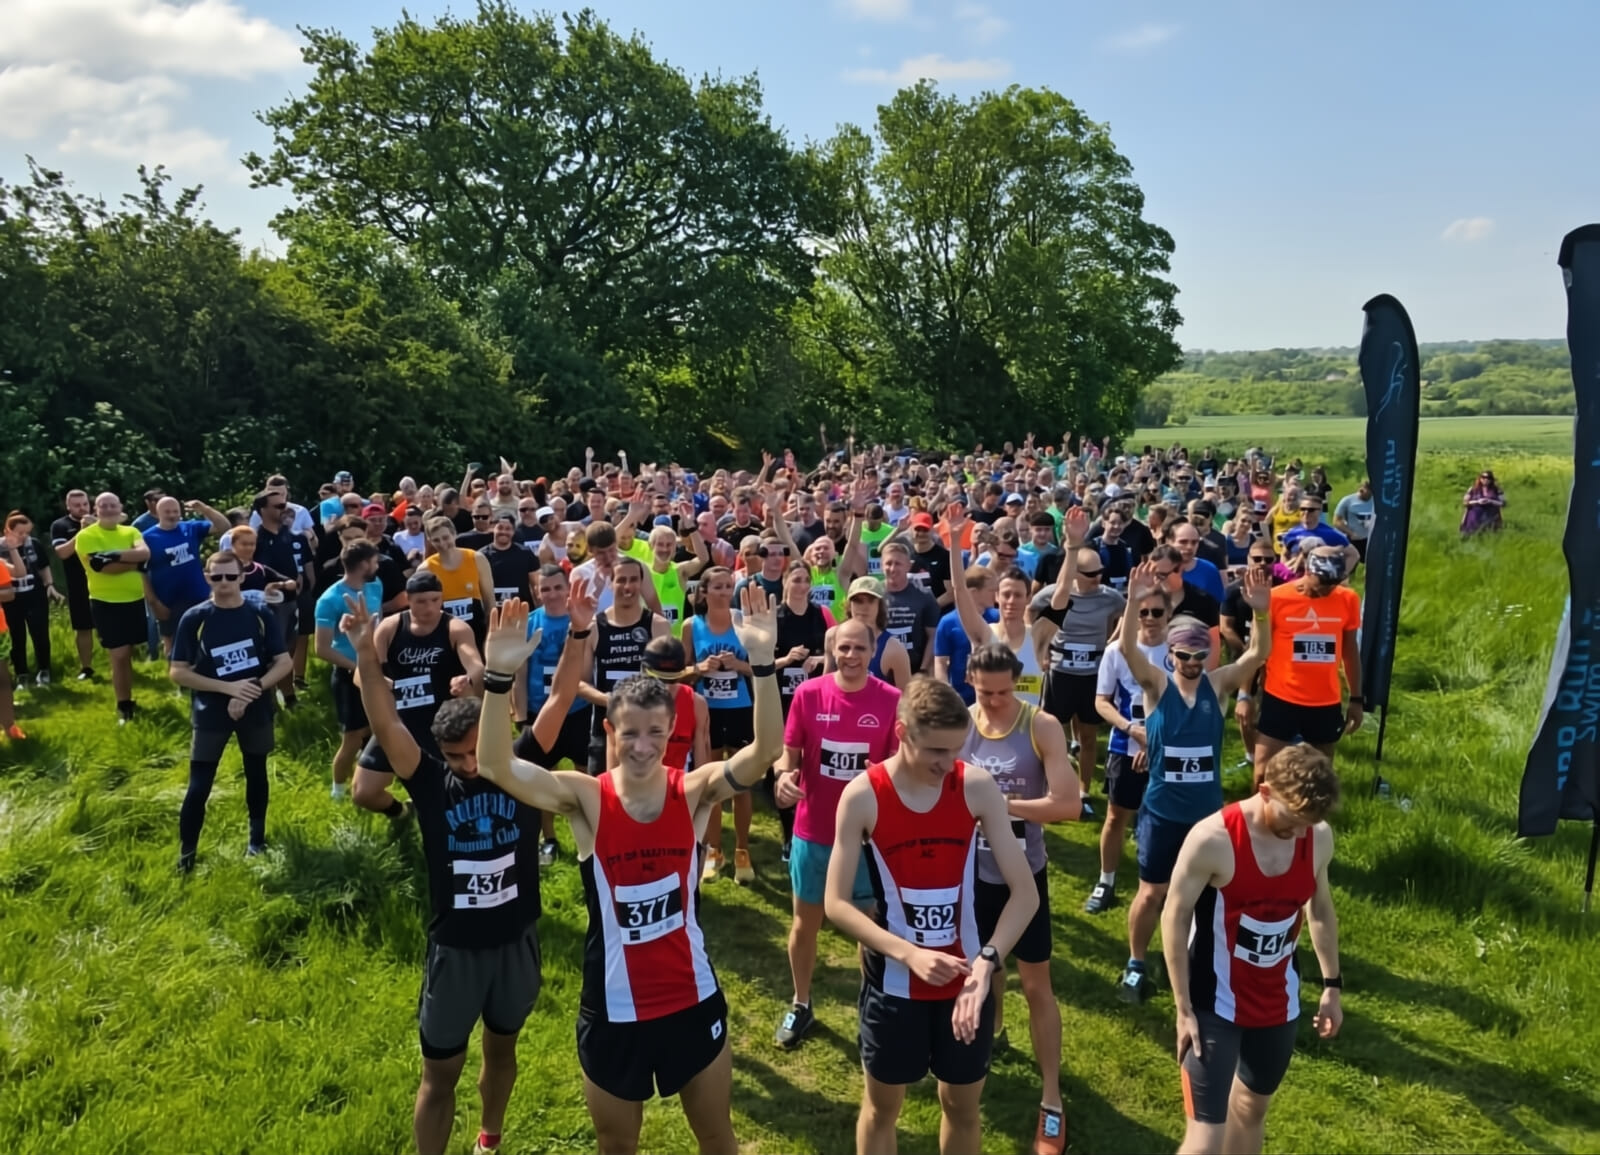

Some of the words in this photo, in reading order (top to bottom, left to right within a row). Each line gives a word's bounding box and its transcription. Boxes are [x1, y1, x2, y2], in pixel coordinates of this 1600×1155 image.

[400, 684, 426, 700] 274
[709, 679, 732, 691] 234
[829, 752, 858, 770] 401
[1180, 757, 1200, 773] 73
[466, 871, 505, 895] 437
[627, 894, 670, 927] 377
[912, 904, 956, 930] 362
[1252, 930, 1289, 955] 147
